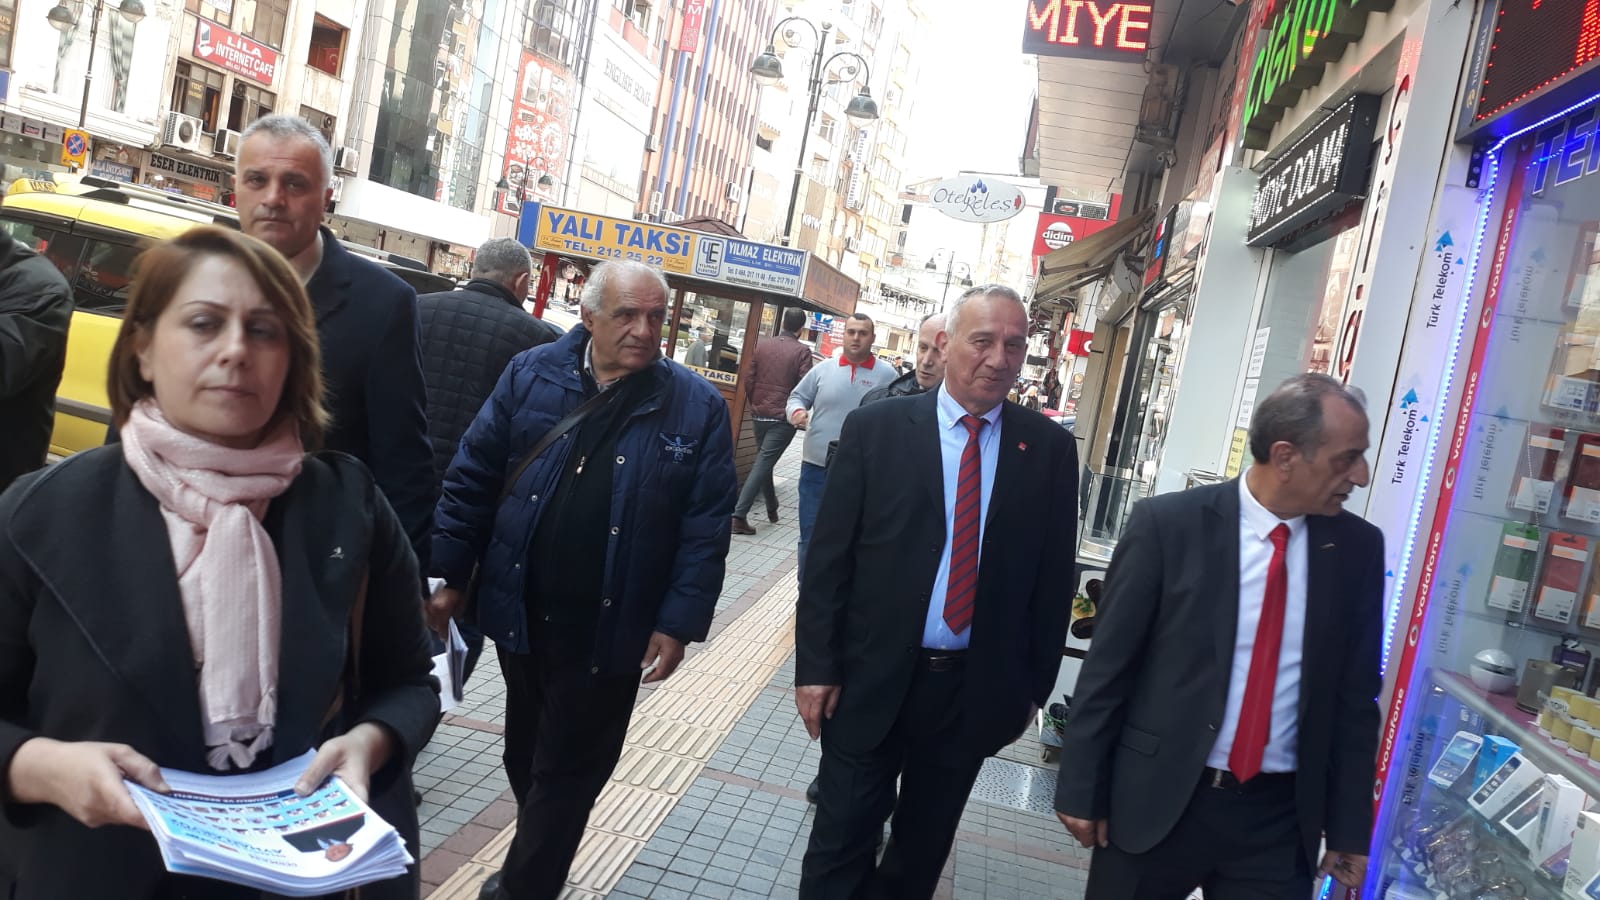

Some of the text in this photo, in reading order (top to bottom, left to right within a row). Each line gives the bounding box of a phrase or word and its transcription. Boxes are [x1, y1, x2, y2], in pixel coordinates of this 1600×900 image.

[253, 58, 274, 77] CAFE
[150, 153, 175, 172] ESER
[548, 211, 604, 241] YALI
[563, 239, 593, 254] TEL:
[596, 246, 622, 258] 212
[626, 251, 643, 263] 25
[647, 255, 664, 266] 22
[728, 241, 758, 260] YILMAZ
[1042, 230, 1074, 243] didim
[1488, 207, 1515, 298] vodafone
[1425, 252, 1453, 329] Türk Telekom
[1452, 371, 1478, 460] vodafone
[1391, 409, 1418, 485] Türk Telekom
[1416, 531, 1441, 618] vodafone
[1380, 688, 1405, 773] vodafone
